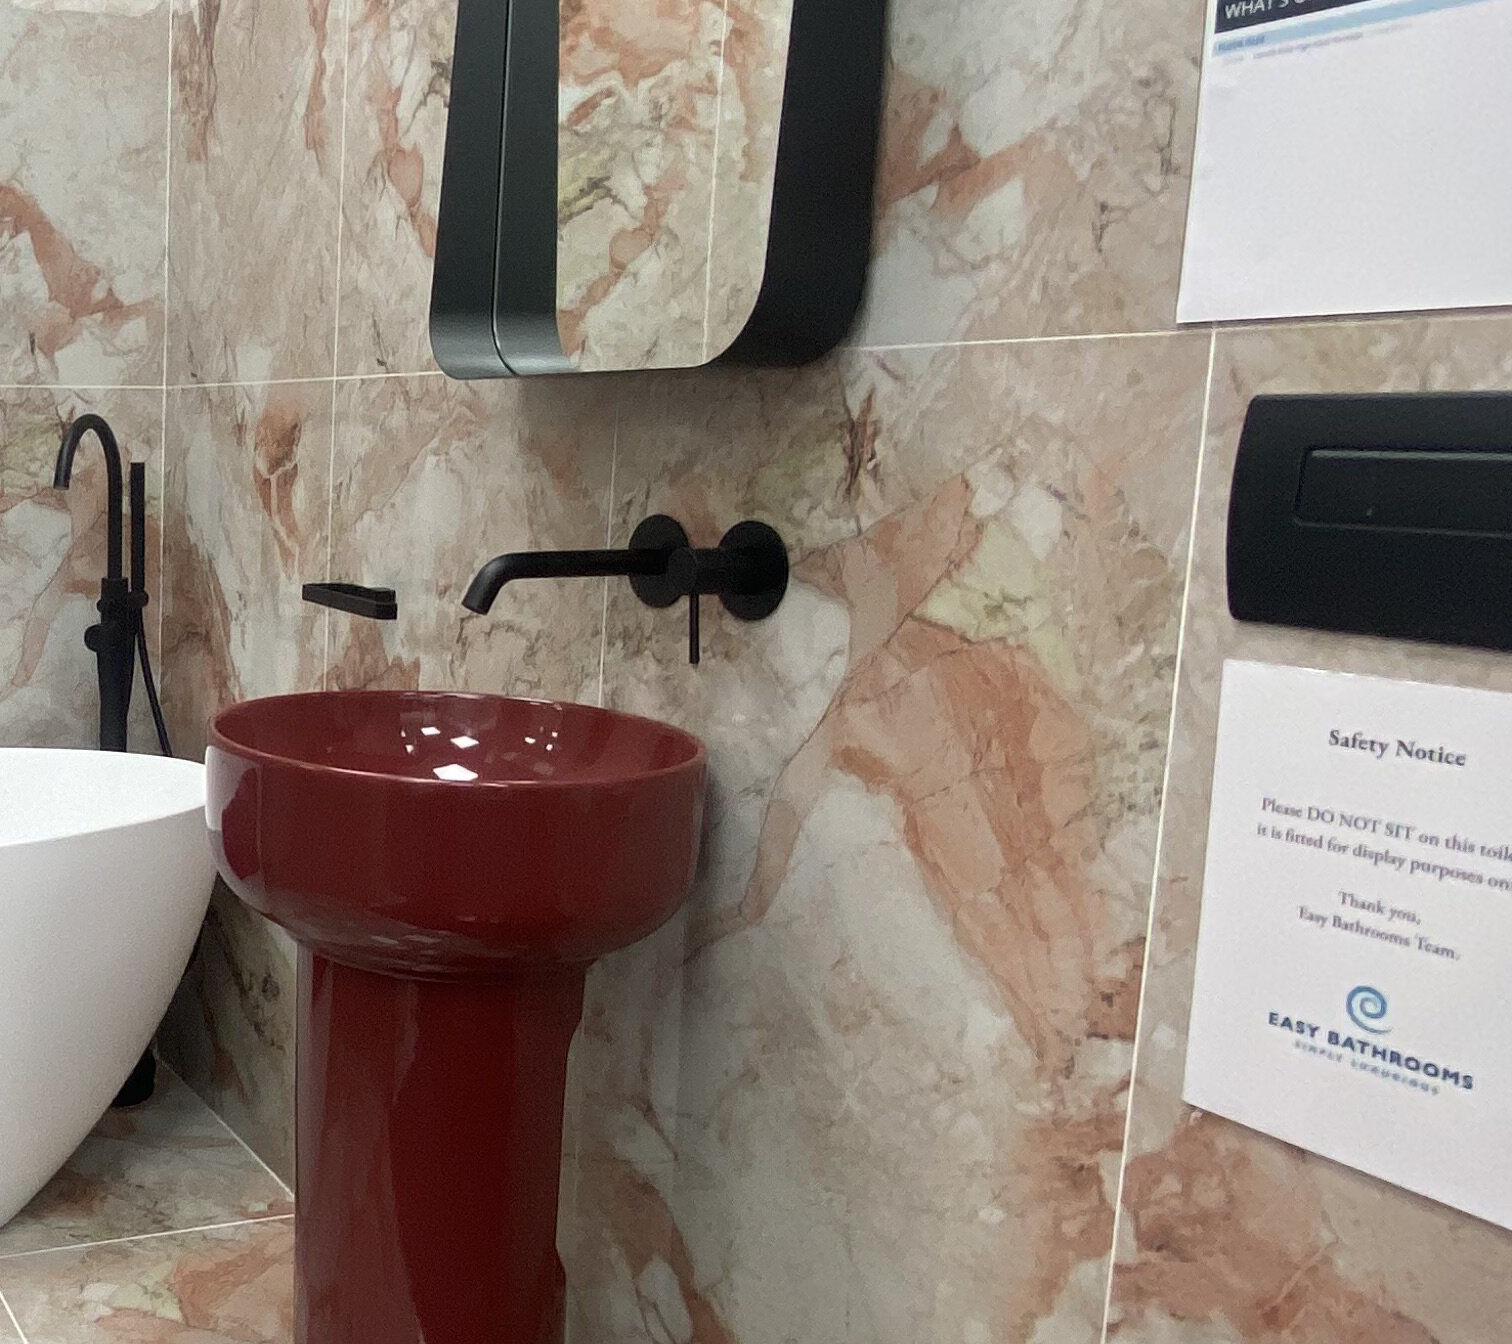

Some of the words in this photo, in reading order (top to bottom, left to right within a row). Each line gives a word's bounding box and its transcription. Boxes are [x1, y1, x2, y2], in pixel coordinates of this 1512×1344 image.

[1328, 729, 1389, 760] Safety
[1394, 739, 1467, 767] Notice
[1262, 797, 1303, 818] Please
[1307, 807, 1335, 825] DO
[1339, 814, 1382, 834] NOT
[1385, 822, 1416, 841] SIT
[1418, 834, 1440, 847] on
[1445, 833, 1476, 853] this
[1257, 823, 1267, 836] it
[1271, 826, 1282, 839] is
[1285, 828, 1324, 849] fitted
[1327, 837, 1349, 854] for
[1352, 845, 1406, 871] display
[1409, 860, 1484, 885] purposes
[1298, 906, 1329, 928] Easy
[1332, 914, 1410, 947] Bathrooms
[1338, 889, 1385, 915] Thank
[1388, 906, 1422, 926] you,
[1268, 1011, 1320, 1038] EASY
[1327, 1030, 1474, 1090] BATHROOMS
